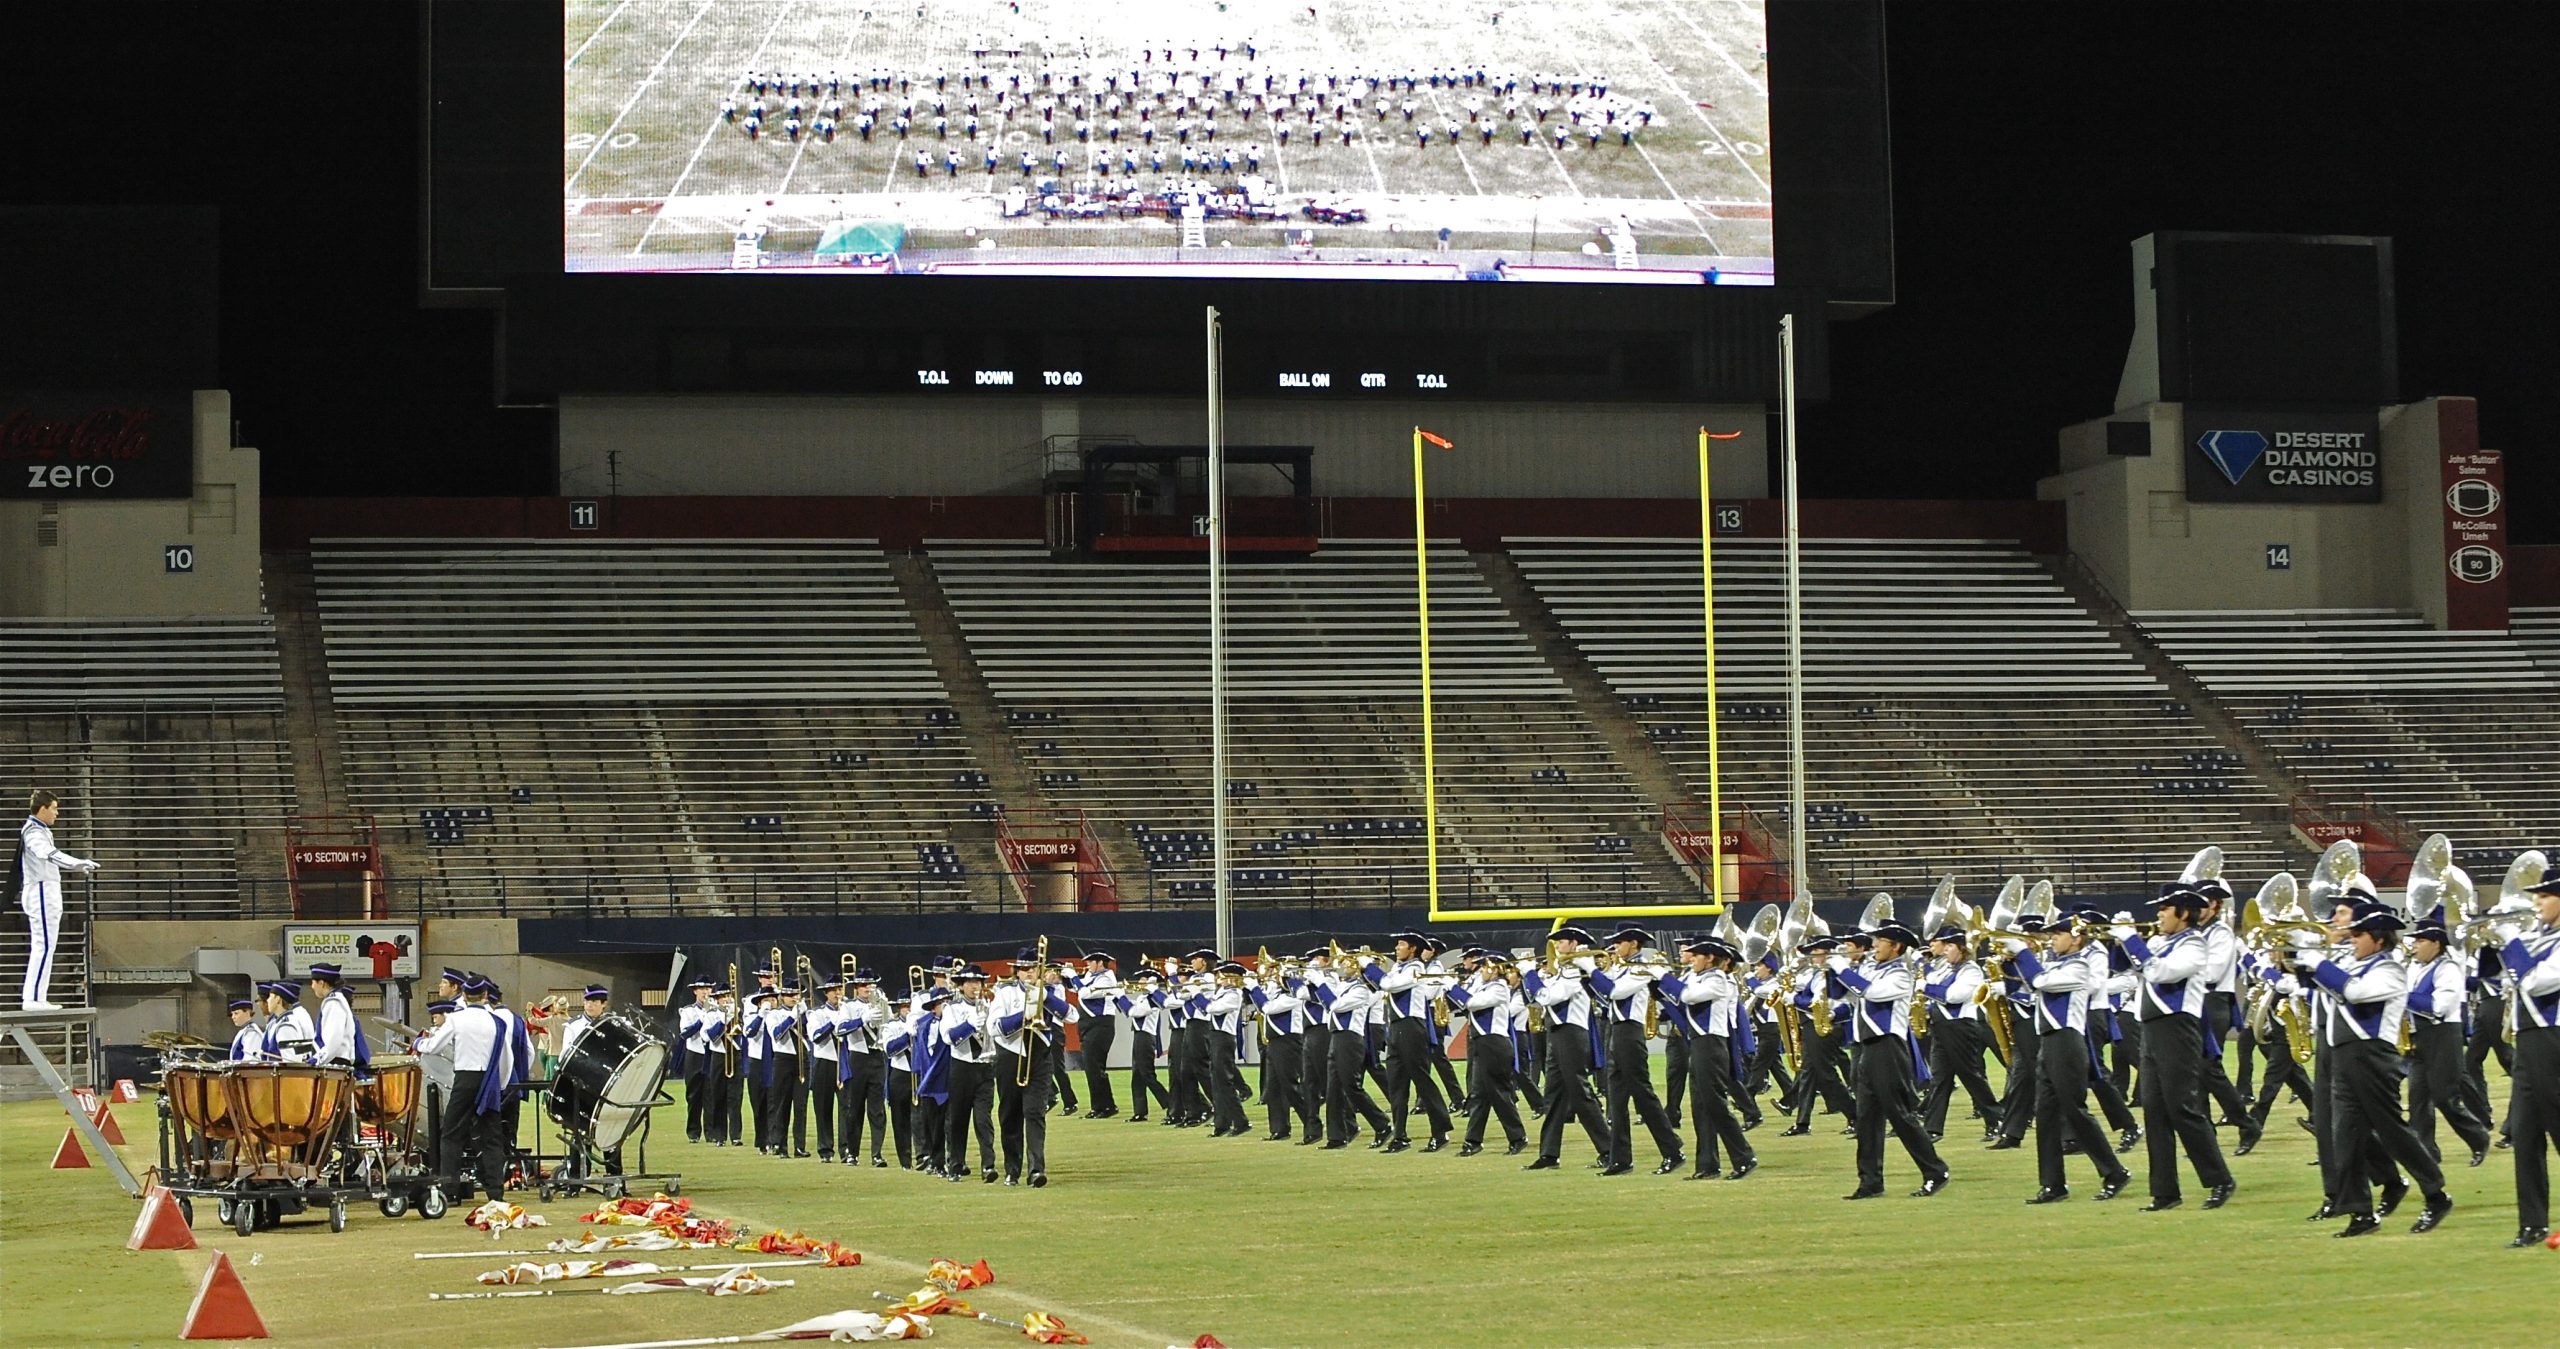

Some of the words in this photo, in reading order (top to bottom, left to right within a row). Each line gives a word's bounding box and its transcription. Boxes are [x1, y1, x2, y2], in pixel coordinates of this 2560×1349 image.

[975, 371, 1013, 385] DOWN
[1043, 371, 1061, 385] TO
[1063, 371, 1083, 386] GO
[1279, 373, 1310, 387] BALL
[1311, 373, 1330, 387] ON
[1360, 373, 1386, 388] QTR
[2275, 432, 2365, 448] DESERT
[2265, 450, 2377, 467] DIAMOND
[2448, 455, 2466, 464] John
[28, 464, 114, 488] zero
[2458, 465, 2487, 475] Salmon
[2268, 469, 2374, 486] CASINOS
[574, 506, 593, 525] 11
[1718, 510, 1741, 528] 13
[2452, 521, 2497, 530] McCollins
[2462, 532, 2489, 541] Umeh
[166, 549, 193, 569] 10
[2267, 548, 2289, 566] 14
[2470, 560, 2484, 570] 90
[1690, 835, 1720, 847] SECTI
[1723, 835, 1732, 846] 13
[303, 853, 313, 863] 10
[315, 851, 349, 863] SECTION
[351, 852, 359, 862] 11
[1024, 844, 1058, 856] SECTION
[1060, 844, 1069, 855] 12
[293, 934, 331, 946] GEAR
[333, 934, 351, 945] UP
[293, 945, 350, 955] WILDCATS
[120, 1082, 139, 1099] G
[77, 1093, 97, 1112] 10
